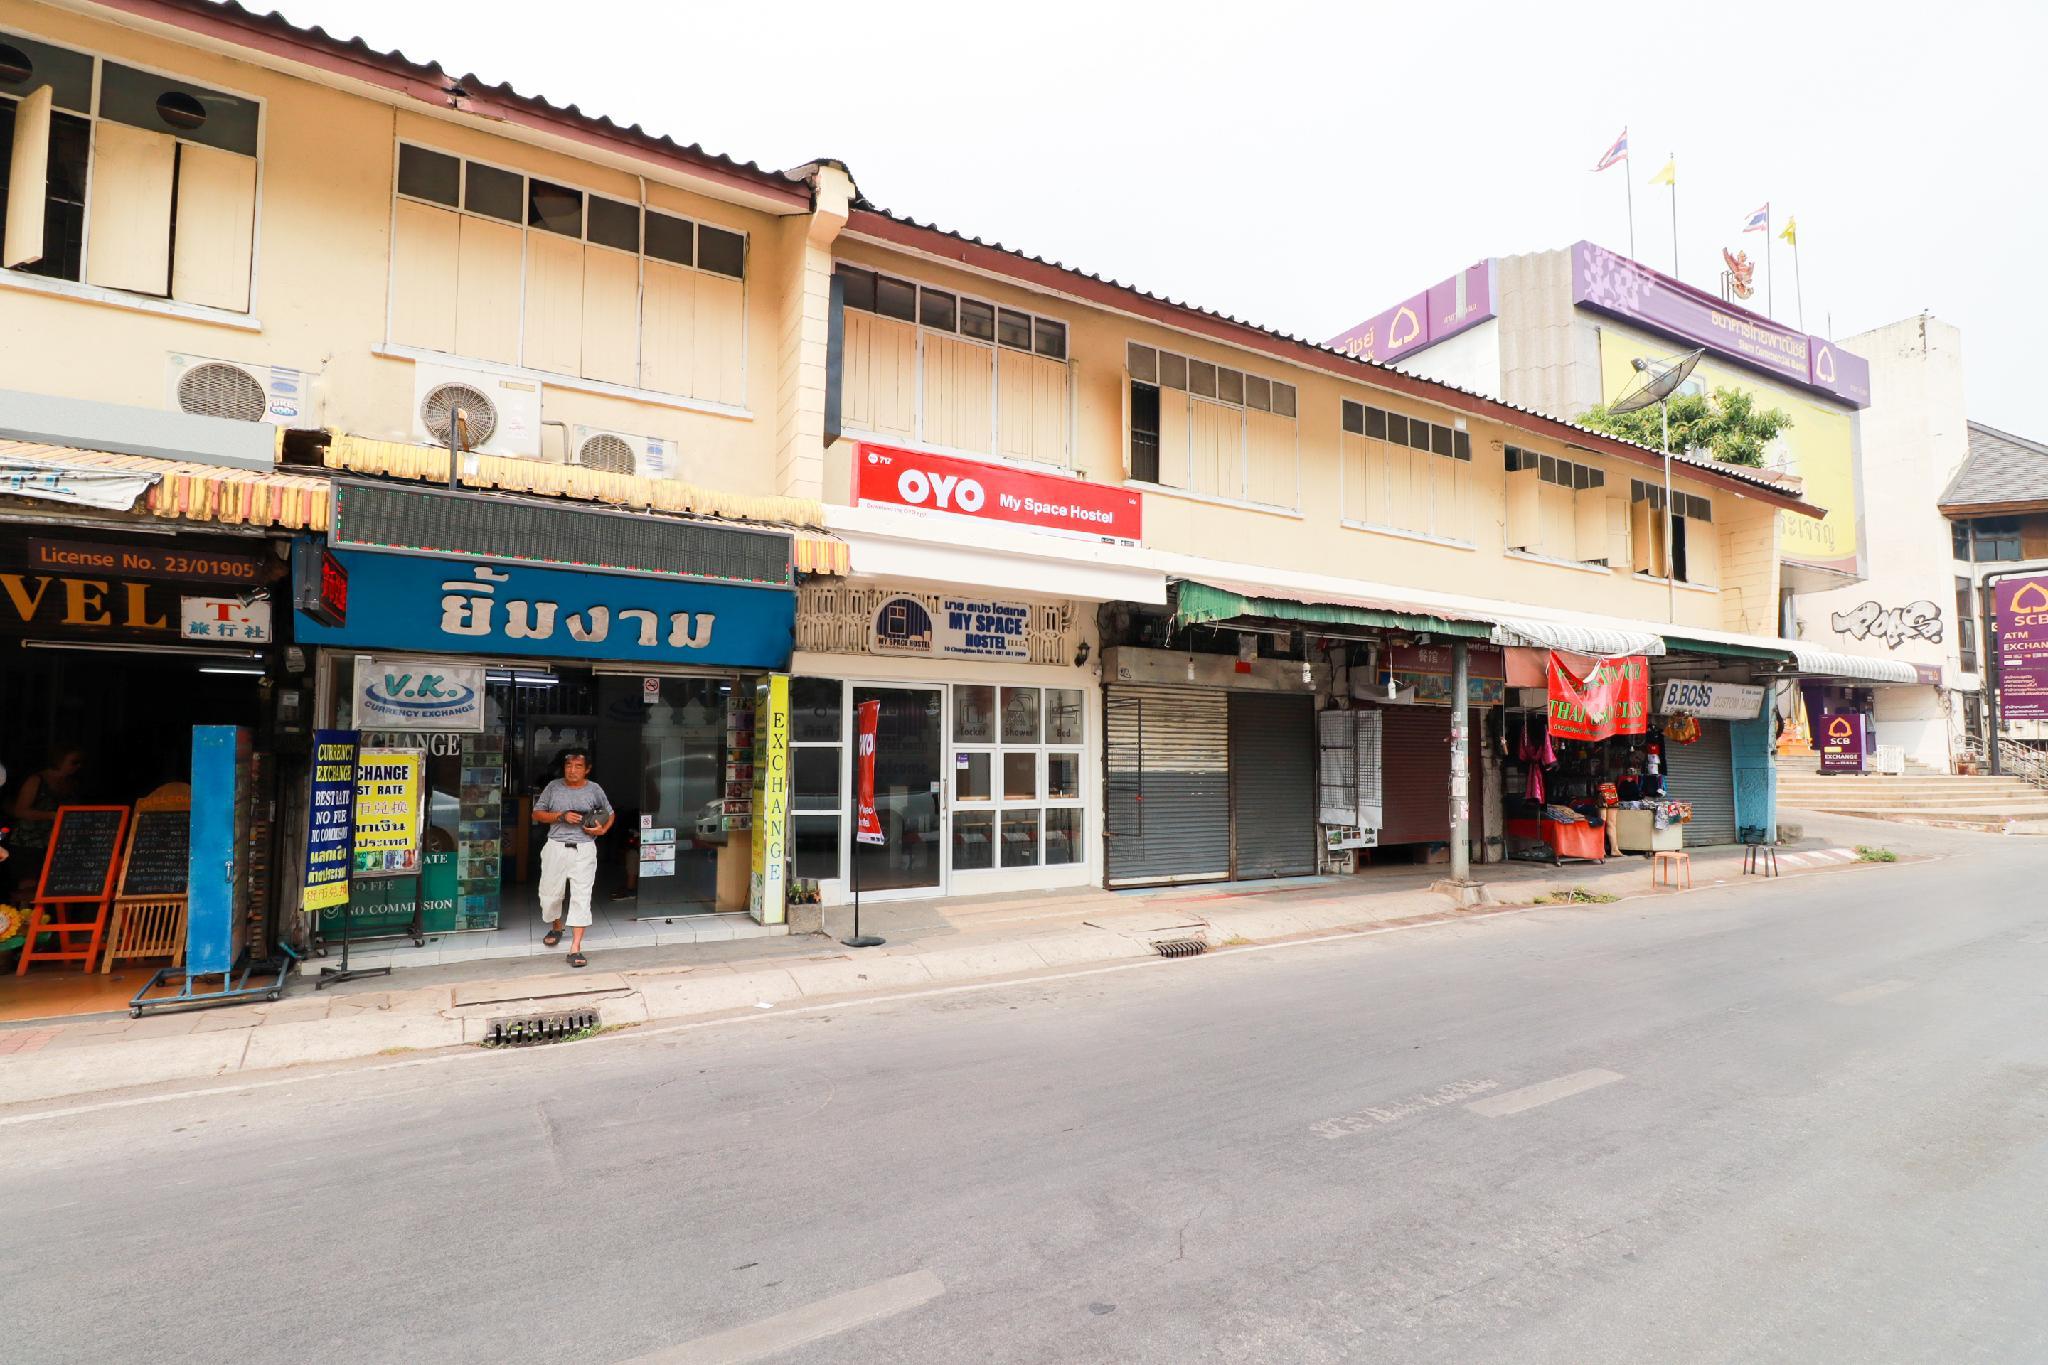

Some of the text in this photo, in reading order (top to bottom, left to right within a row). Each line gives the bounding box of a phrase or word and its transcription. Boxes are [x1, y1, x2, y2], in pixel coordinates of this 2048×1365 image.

[898, 469, 1113, 524] OYO My Space Hostel
[41, 546, 254, 578] License No. 23/01905
[441, 566, 715, 648] ยิ้มงาม
[949, 612, 1022, 635] MY SPACE
[2015, 614, 2048, 626] SCB
[188, 621, 265, 639] 旅行社
[2004, 631, 2028, 639] ATM
[909, 640, 930, 648] HOSTEL
[966, 634, 1006, 649] HOSTEL
[385, 674, 458, 697] V.K.
[1667, 683, 1712, 707] B.BOSS
[364, 700, 476, 718] CURRENCY EXCHANGE
[1550, 700, 1586, 723] THAI
[1057, 728, 1071, 738] Bed
[318, 744, 354, 761] CURRENCY
[369, 733, 460, 757] CHANGE
[316, 765, 352, 782] EXCHANGE
[357, 765, 409, 780] CHANGE
[315, 790, 335, 806] BEST
[357, 785, 404, 796] ST RATE
[769, 712, 785, 880] EXCHANGE
[315, 809, 347, 826] NO FEE
[311, 829, 320, 843] NO
[423, 854, 448, 865] ATE
[370, 880, 395, 890] FEE
[370, 899, 453, 914] COMMISION
